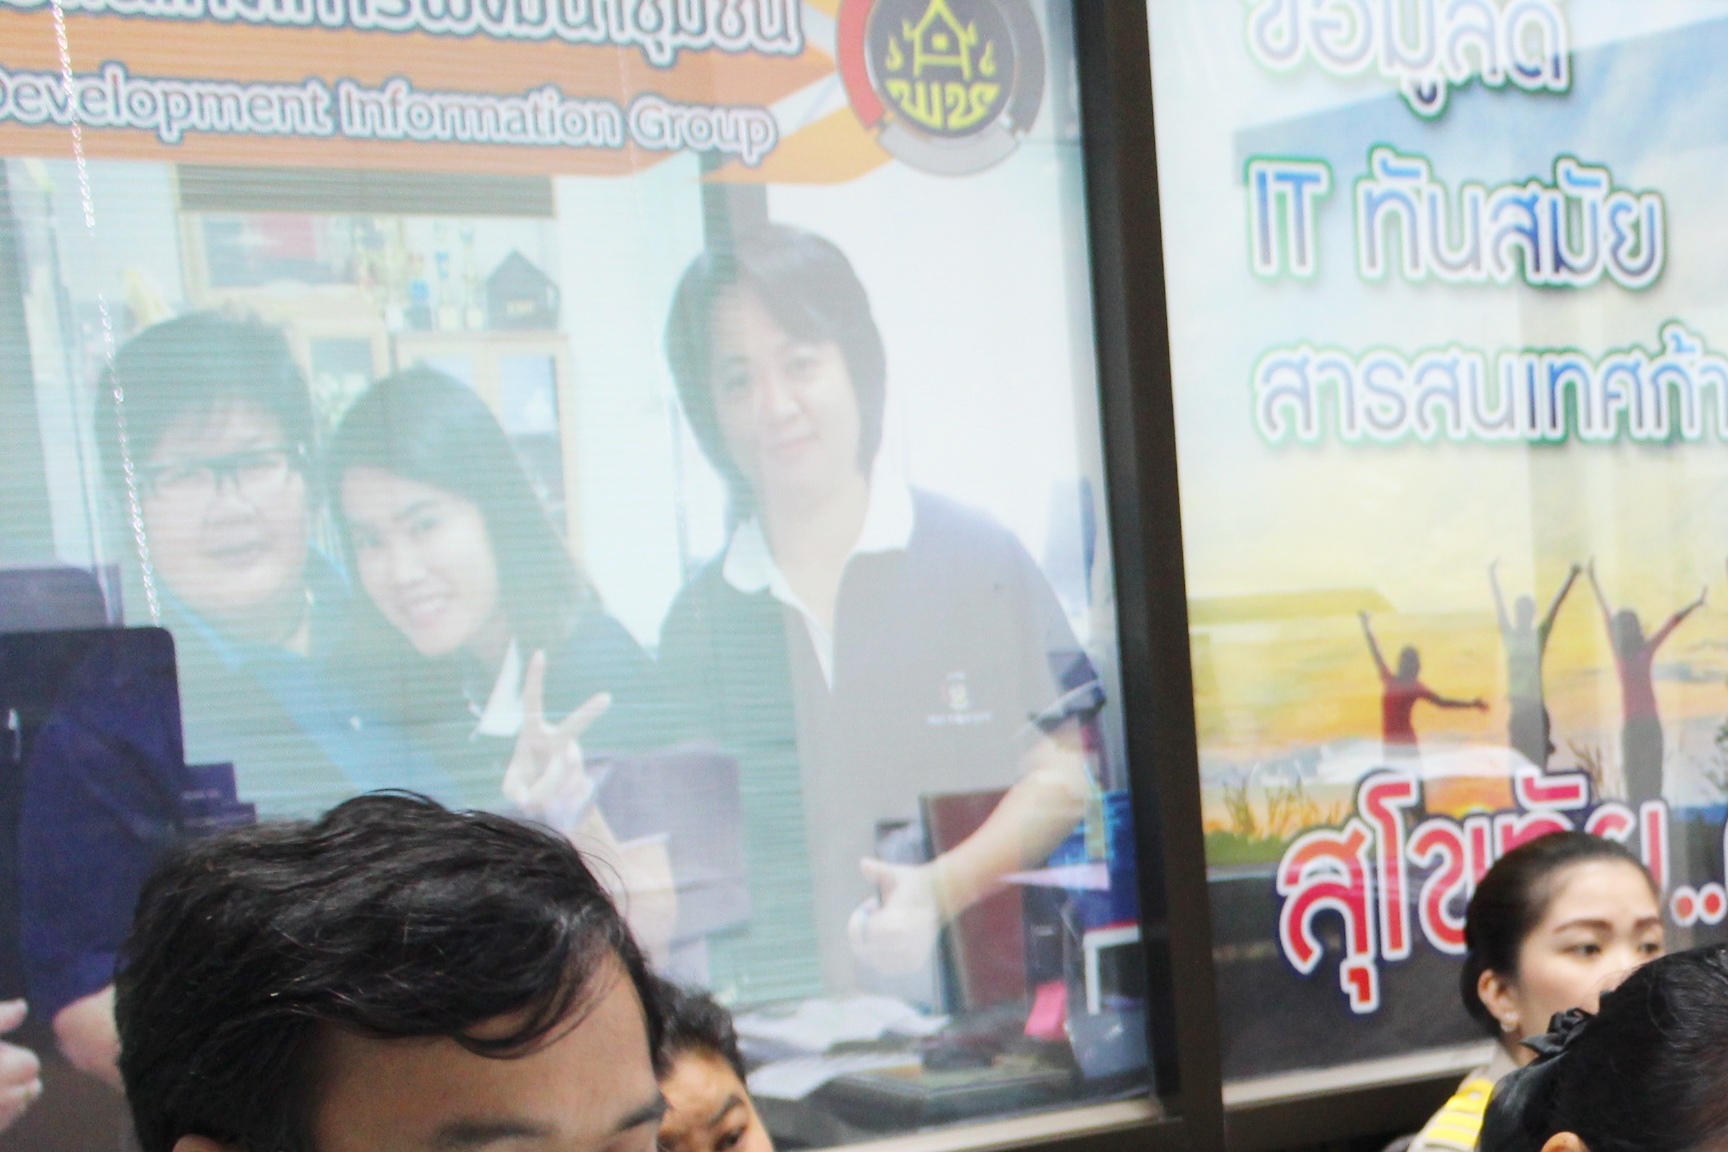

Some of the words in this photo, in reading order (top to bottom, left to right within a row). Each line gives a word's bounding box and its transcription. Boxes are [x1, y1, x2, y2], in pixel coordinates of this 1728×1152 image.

[338, 77, 625, 146] Information
[629, 94, 777, 165] Group
[1250, 160, 1328, 276] IT
[1357, 148, 1662, 287] ทันสมัย
